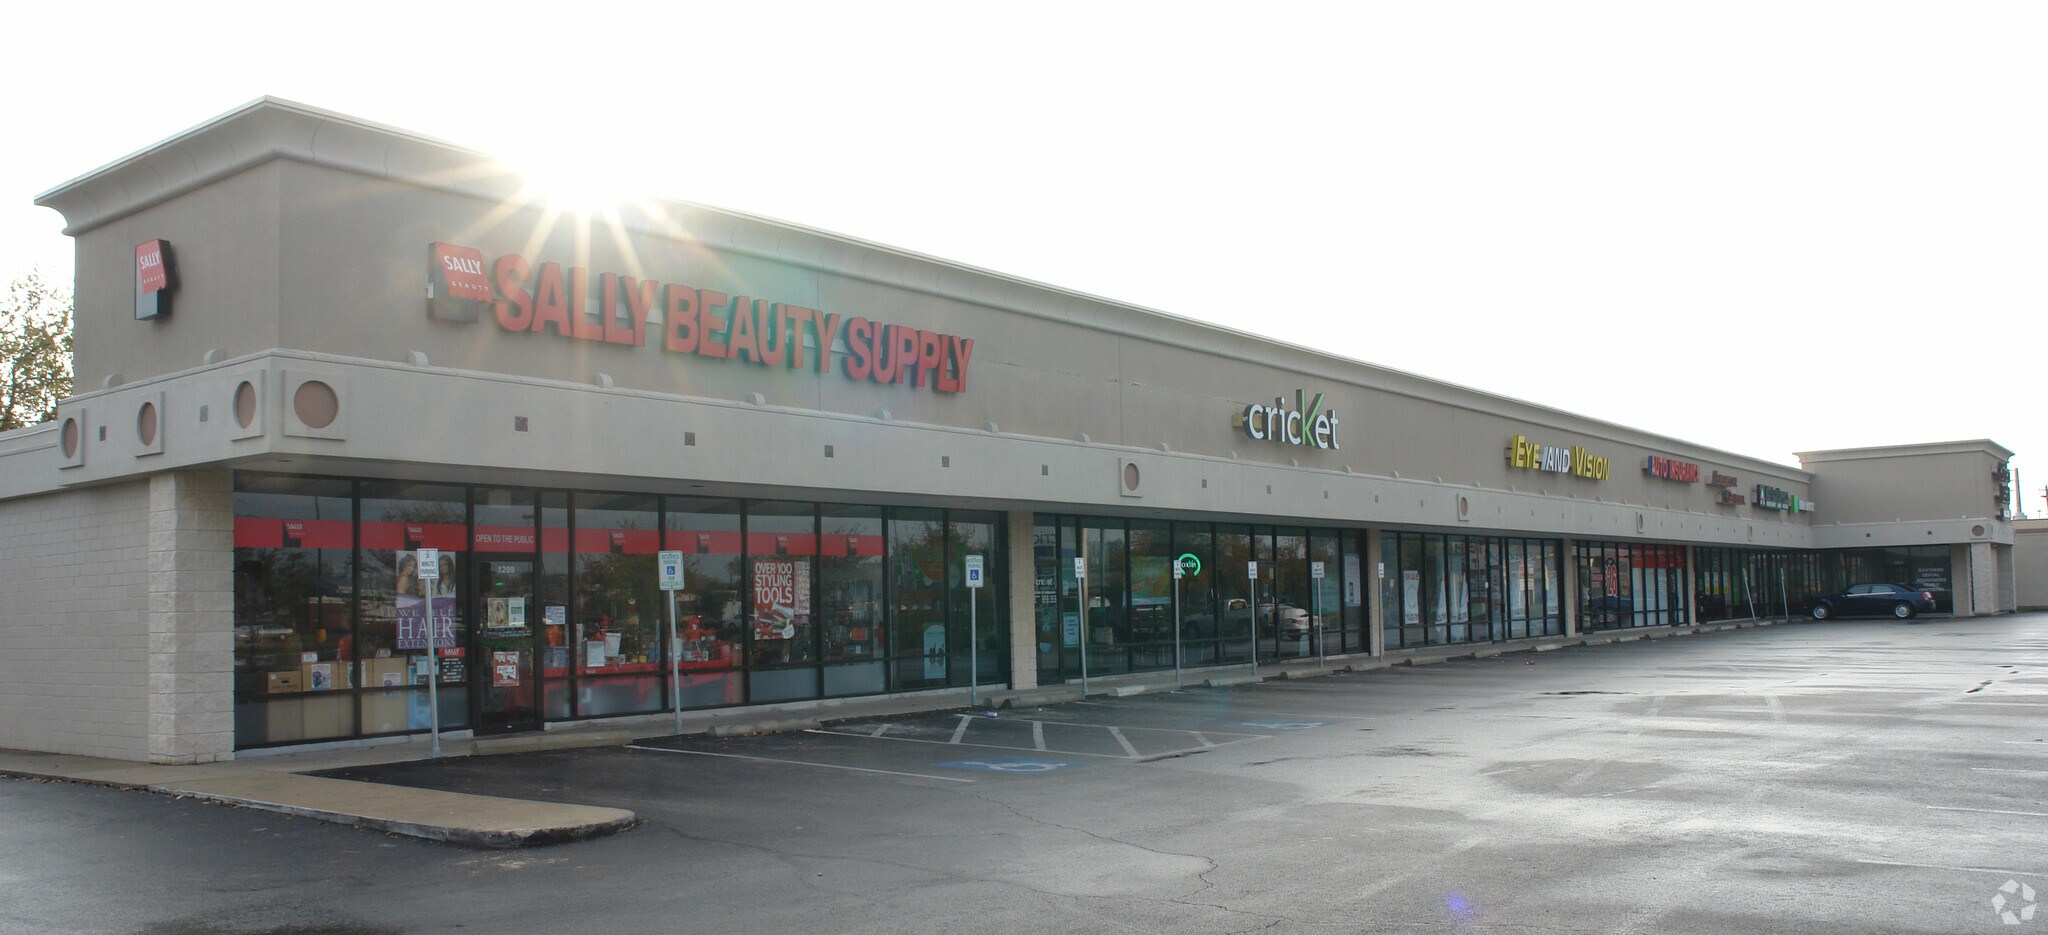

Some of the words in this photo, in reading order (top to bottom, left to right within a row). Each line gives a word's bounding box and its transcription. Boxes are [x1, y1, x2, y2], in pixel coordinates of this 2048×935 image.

[140, 251, 161, 270] SALLY
[443, 255, 482, 275] SALLY
[451, 281, 489, 291] BEAUTY
[495, 253, 658, 347] SALLY
[663, 283, 841, 373] BEAUTY
[843, 316, 974, 393] SUPPLY
[1543, 446, 1570, 473] AND
[1651, 455, 1669, 479] AUTO
[476, 534, 492, 543] OPEN
[493, 534, 501, 543] TO
[501, 535, 513, 544] THE
[514, 535, 534, 544] PUBLIC
[497, 566, 515, 574] 1209
[755, 562, 776, 574] OVER
[777, 563, 793, 574] 100
[755, 574, 793, 587] STYLING
[755, 587, 793, 604] TOOLS
[399, 609, 420, 617] WE
[398, 617, 455, 639] HAIR
[398, 639, 456, 649] EXTENIONS
